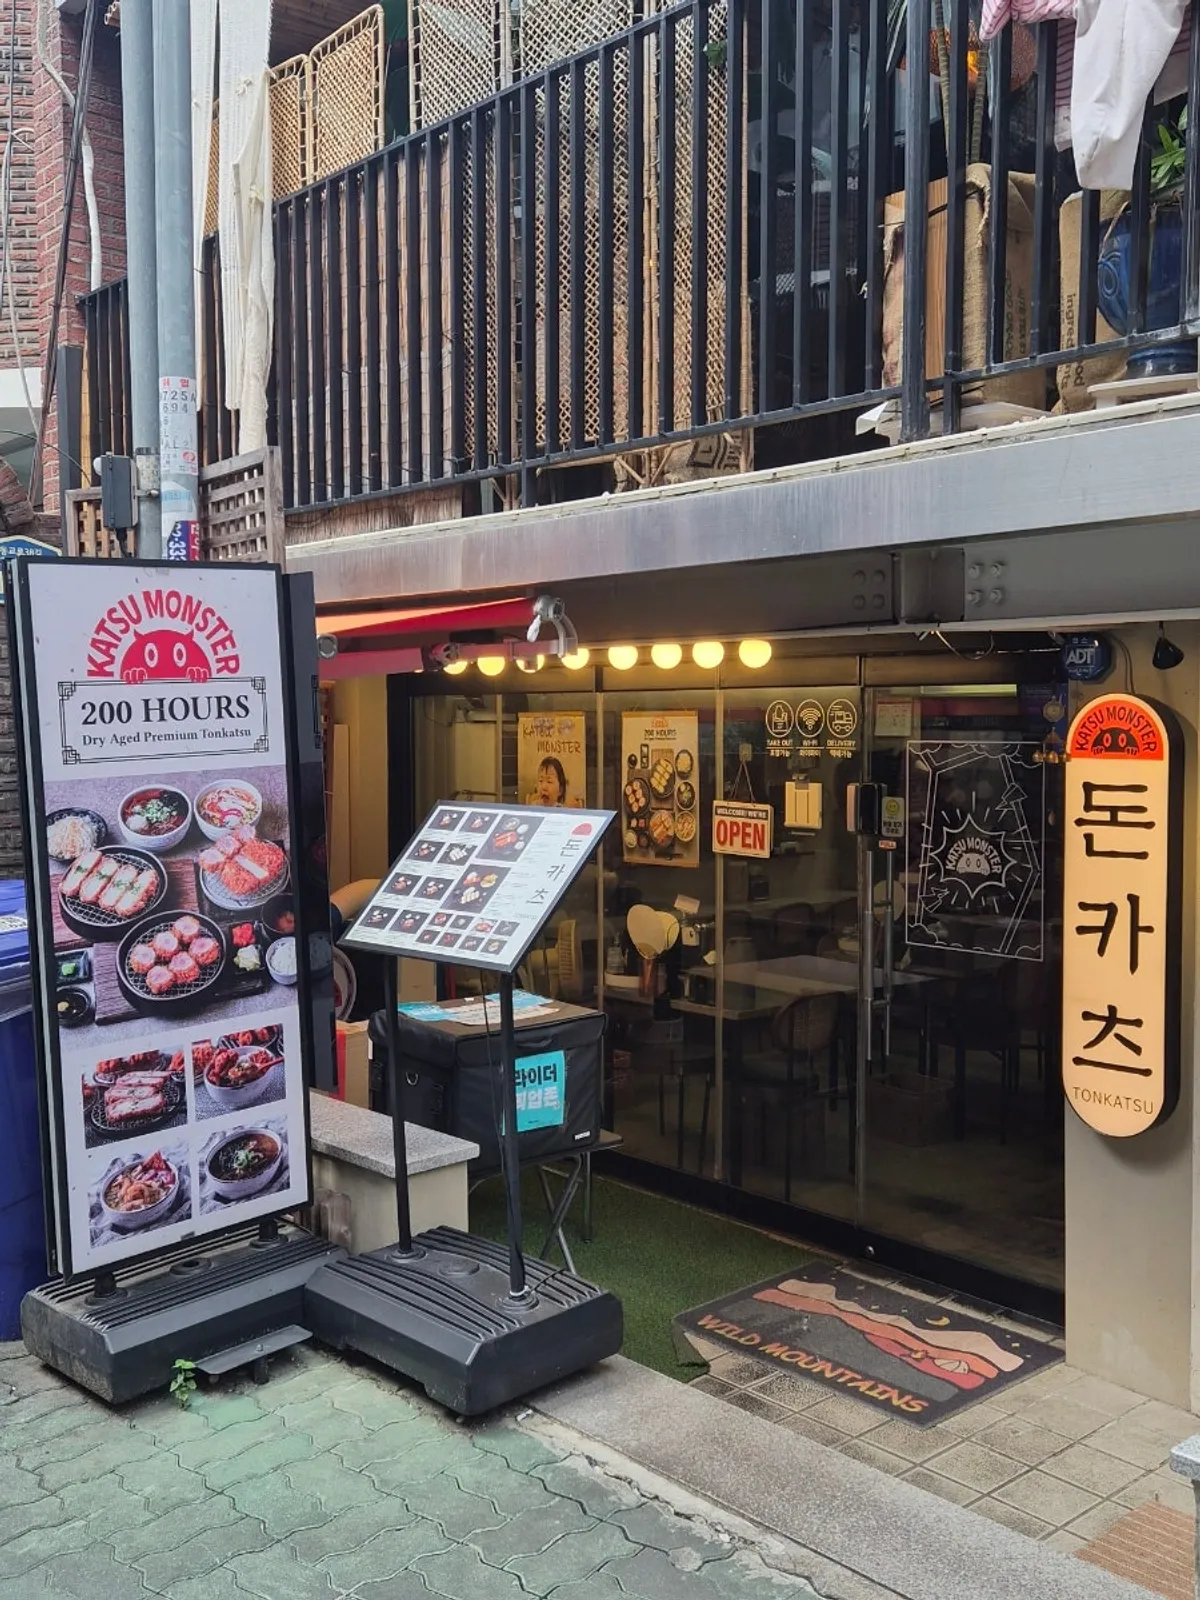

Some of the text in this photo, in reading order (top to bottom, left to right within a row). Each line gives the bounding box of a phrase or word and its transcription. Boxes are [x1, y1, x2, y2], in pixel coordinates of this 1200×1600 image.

[87, 589, 240, 677] KATSU MONSTER
[1065, 648, 1095, 664] ADT
[81, 694, 250, 725] 200 HOURS
[82, 727, 252, 748] Dry Aged Premium Tonkatsu
[1075, 705, 1158, 753] KATSU MONSTER
[537, 740, 581, 754] MONSTER
[716, 819, 765, 850] OPEN
[945, 837, 1003, 873] KATSU MONSTER
[1072, 781, 1156, 1077] 돈카츠
[1072, 1086, 1155, 1115] TONKATSU
[696, 1313, 930, 1414] WILD MOUNTAINS
